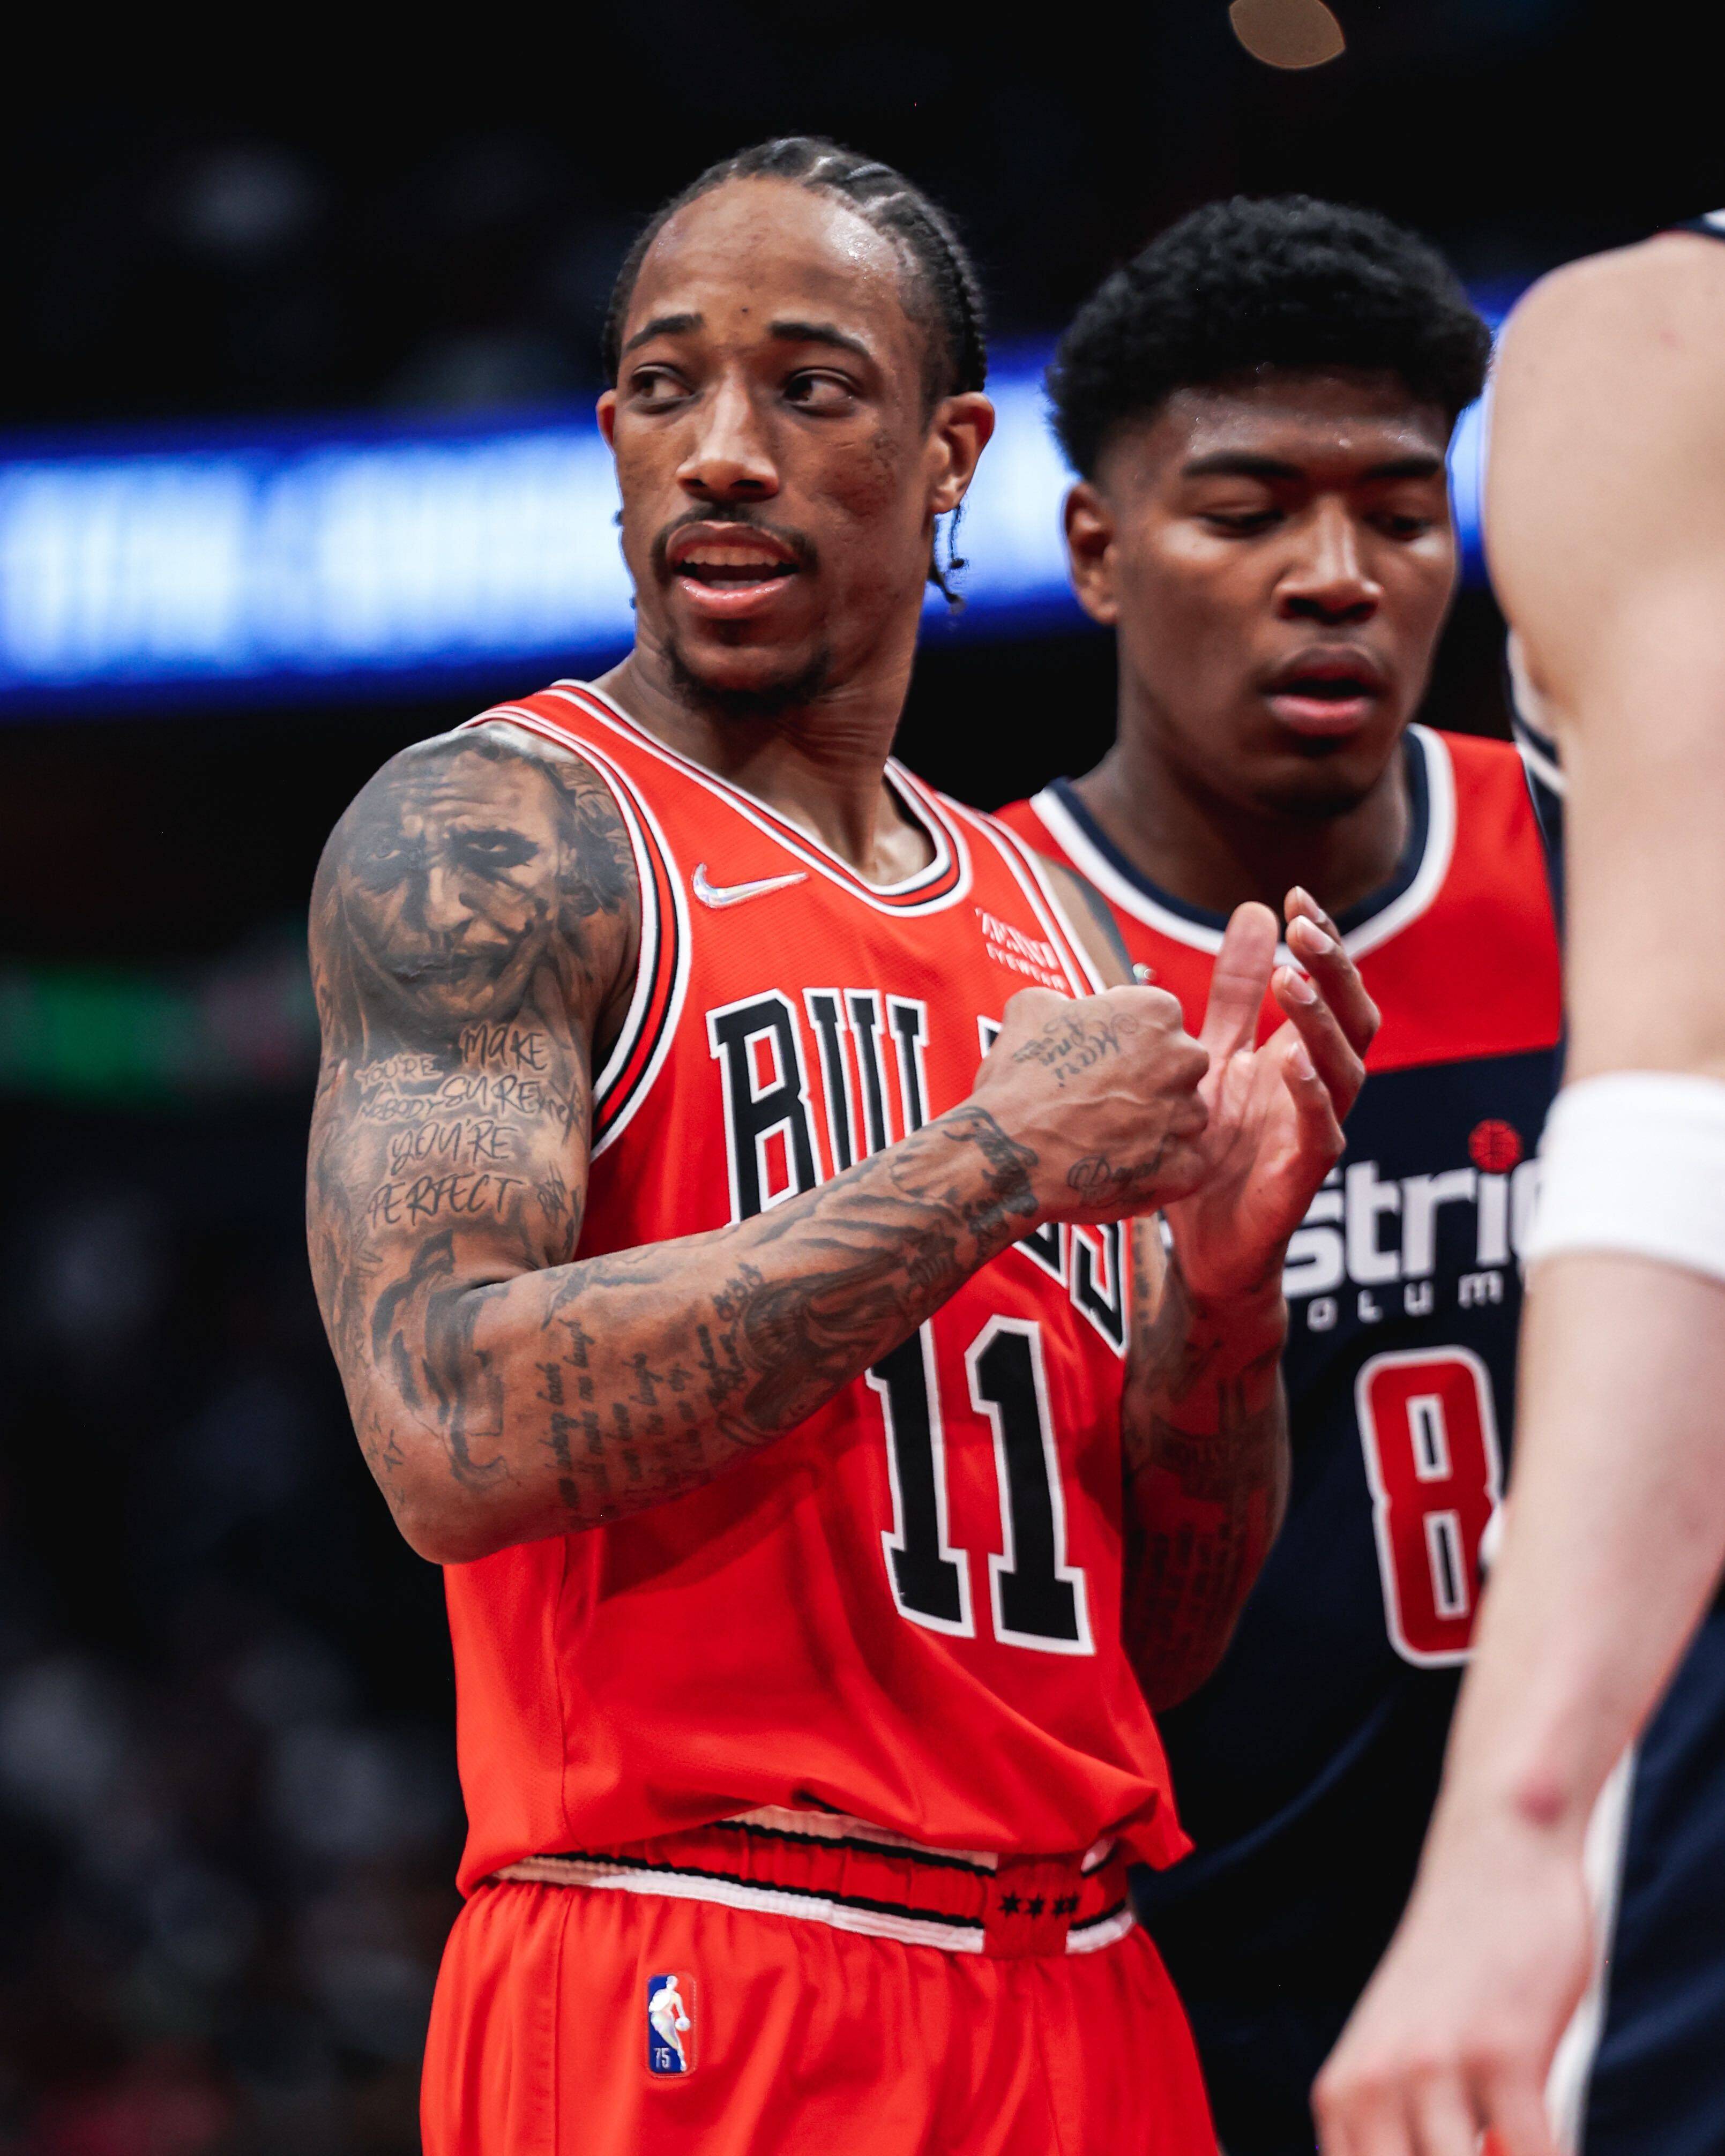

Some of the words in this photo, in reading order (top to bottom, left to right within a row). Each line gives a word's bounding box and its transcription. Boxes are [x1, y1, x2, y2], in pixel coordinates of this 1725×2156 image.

[368, 1171, 524, 1229] PERFECT
[865, 1314, 1096, 1656] 11
[1354, 1344, 1504, 1670] 8
[653, 2047, 671, 2070] 75
